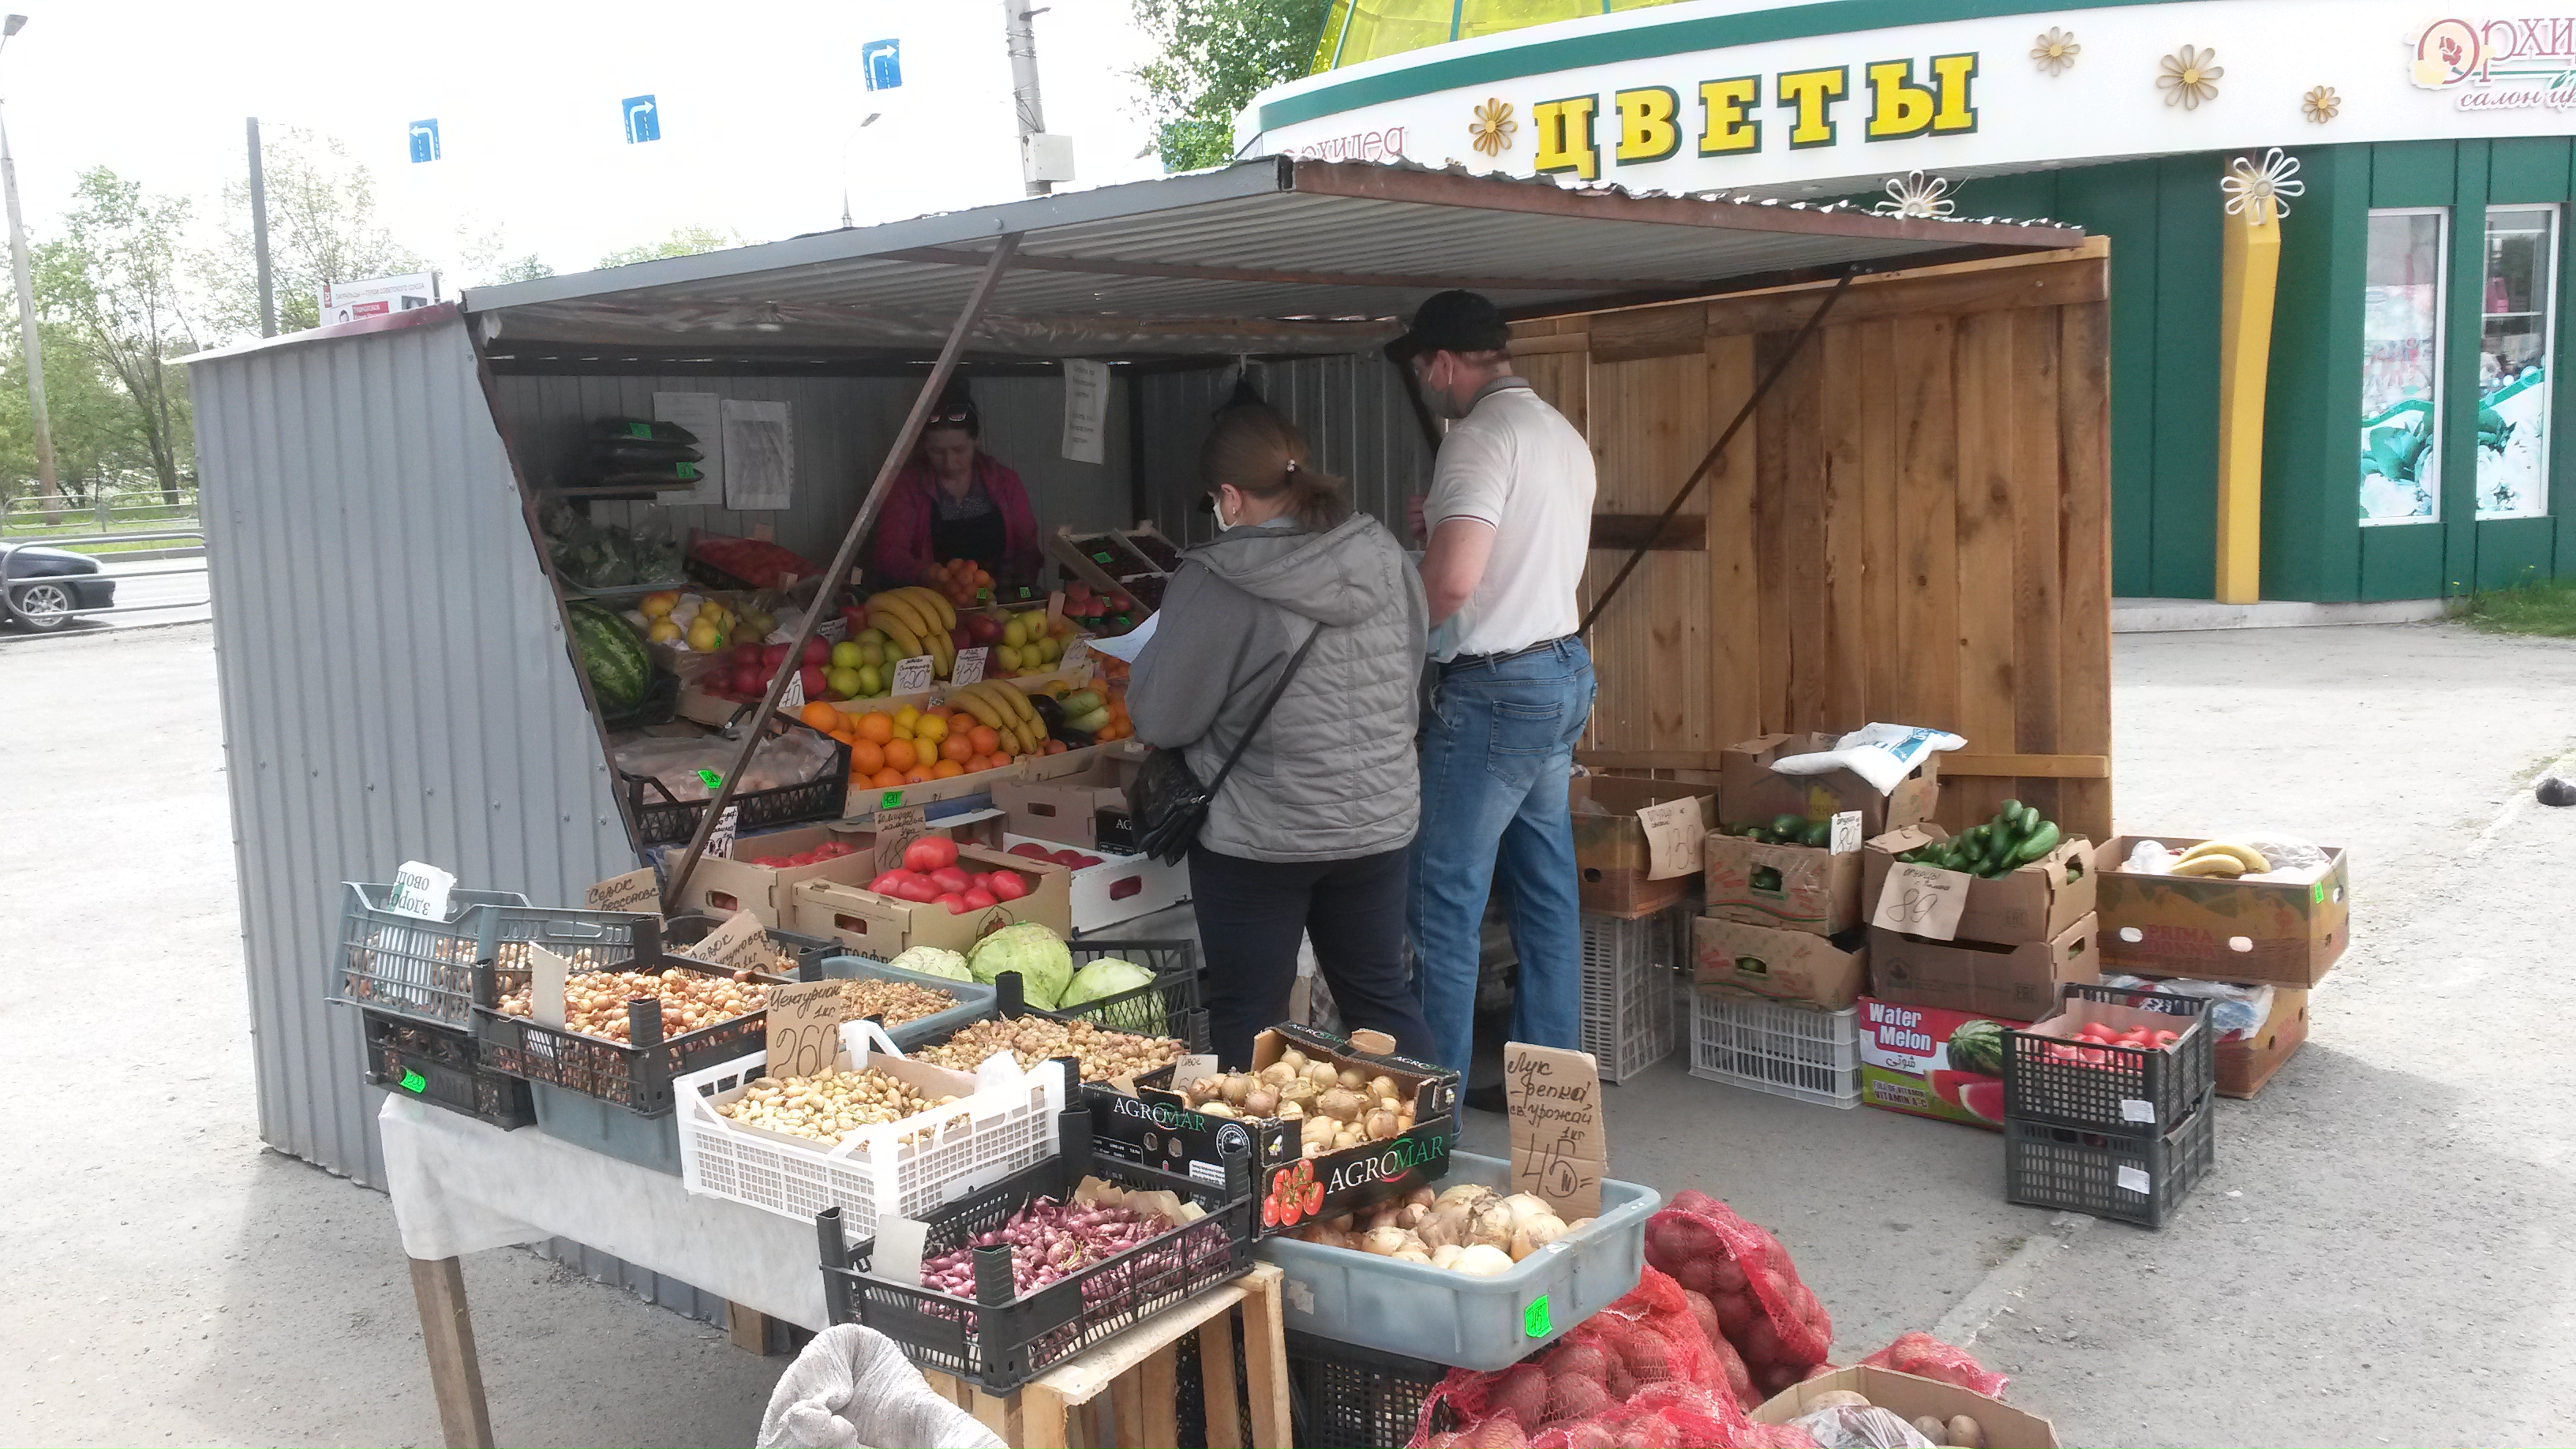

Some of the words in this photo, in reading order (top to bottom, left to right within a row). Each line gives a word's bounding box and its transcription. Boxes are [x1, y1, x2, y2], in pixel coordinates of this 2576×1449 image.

[2460, 89, 2543, 107] салон
[1532, 52, 1978, 181] ЦВЕТЫ
[899, 669, 927, 689] 120
[1886, 888, 1938, 923] 89
[1869, 1002, 1923, 1029] Water
[772, 1024, 839, 1079] 260
[1879, 1024, 1931, 1051] Melon
[1507, 1052, 1552, 1086] Лук
[1874, 1091, 1911, 1105] VITAMIN
[1113, 1097, 1208, 1133] AGROMAR
[1528, 1103, 1593, 1127] урожай
[1327, 1136, 1444, 1194] AGROMAR
